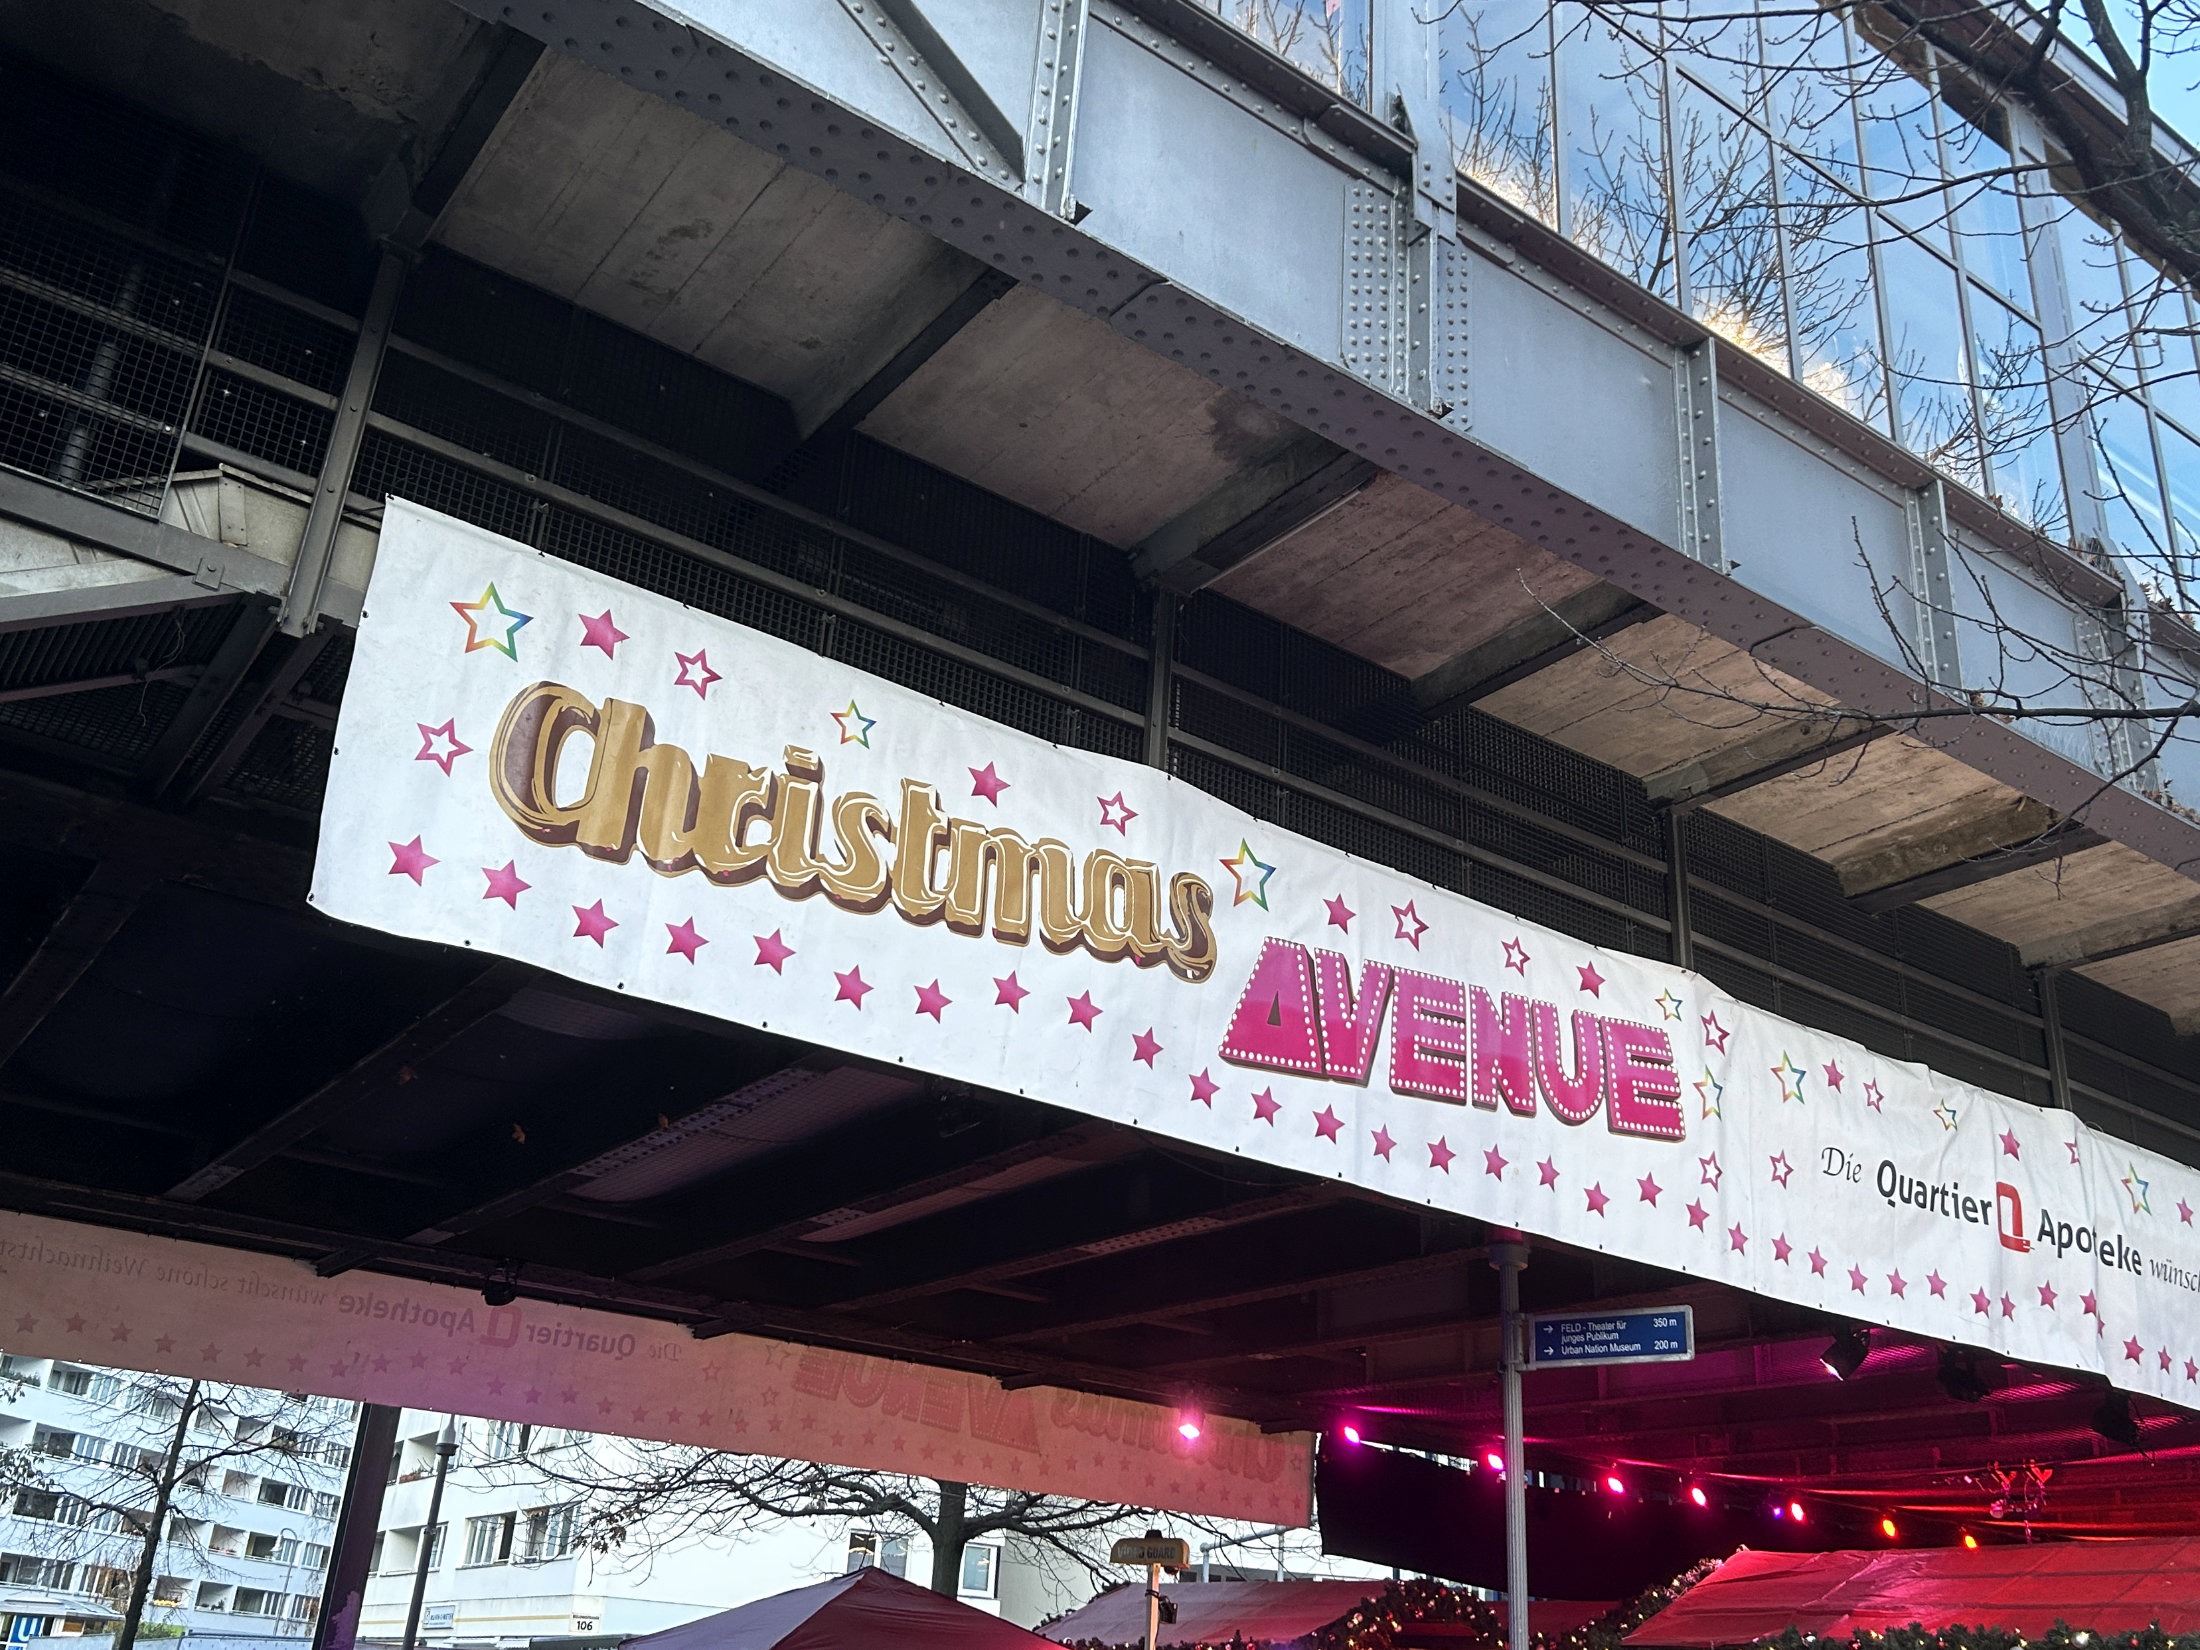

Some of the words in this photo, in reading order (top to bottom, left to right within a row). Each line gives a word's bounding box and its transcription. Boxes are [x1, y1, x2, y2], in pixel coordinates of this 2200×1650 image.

[488, 680, 1218, 984] Christmas
[1217, 936, 1687, 1142] AVENUE
[1821, 1147, 1862, 1183] Die
[1876, 1159, 1992, 1226] Quartier
[1561, 1322, 1581, 1332] FELD
[1587, 1321, 1615, 1332] Theater
[1616, 1320, 1627, 1330] für
[1653, 1318, 1668, 1328] 350
[1561, 1333, 1585, 1344] junges
[1586, 1331, 1619, 1342] Publikum
[1561, 1345, 1584, 1355] Urban
[1584, 1343, 1608, 1354] Nation
[1609, 1342, 1642, 1352] Museum
[1654, 1340, 1669, 1350] 200
[1670, 1341, 1678, 1349] m
[1146, 1547, 1176, 1559] GUARD
[577, 1620, 594, 1631] 106
